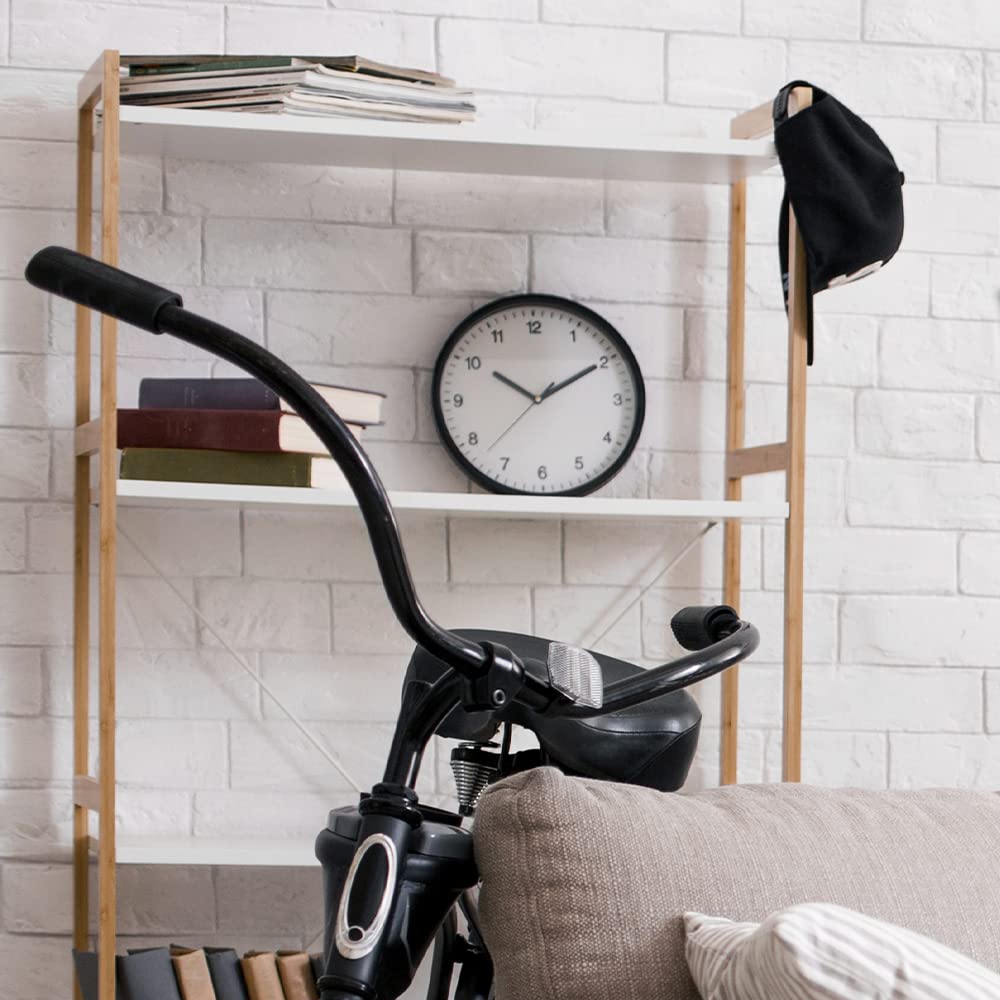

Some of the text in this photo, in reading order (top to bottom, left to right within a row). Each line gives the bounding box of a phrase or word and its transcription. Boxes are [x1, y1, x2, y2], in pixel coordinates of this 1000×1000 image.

[526, 321, 542, 335] 12
[491, 329, 503, 343] 11
[569, 330, 576, 342] 1
[465, 355, 481, 370] 10
[599, 357, 609, 369] 2
[453, 393, 463, 407] 9
[612, 393, 623, 406] 3
[467, 432, 478, 445] 8
[602, 431, 612, 444] 4
[499, 457, 510, 471] 7
[573, 456, 584, 469] 5
[537, 465, 548, 479] 6
